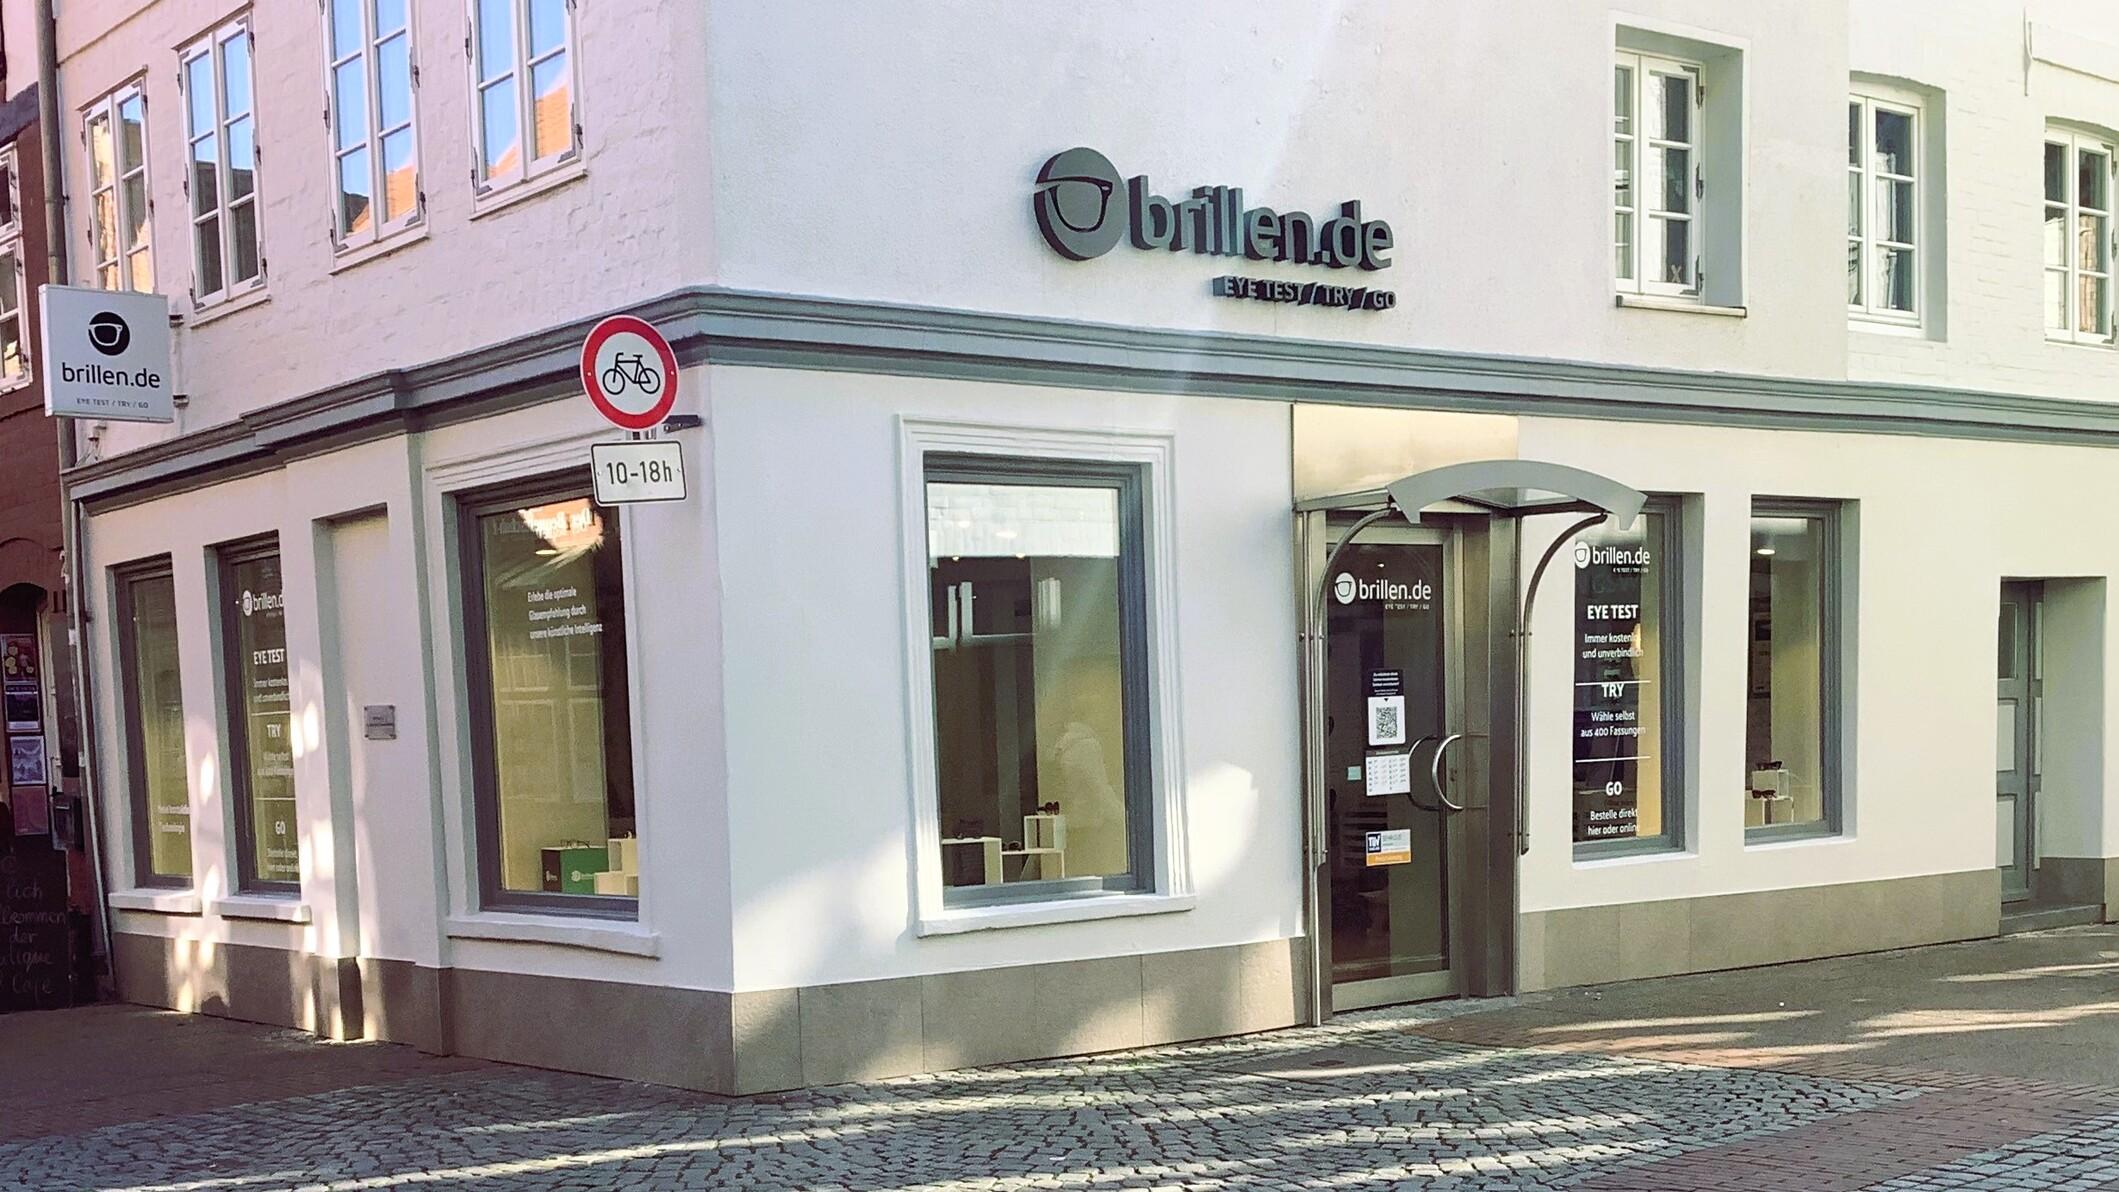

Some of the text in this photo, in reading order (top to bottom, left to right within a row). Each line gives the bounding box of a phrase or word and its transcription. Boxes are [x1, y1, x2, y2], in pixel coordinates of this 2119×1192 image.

[1128, 175, 1394, 270] brillen.de
[1214, 276, 1258, 299] EYE
[1260, 280, 1305, 304] TEST
[1321, 284, 1354, 308] TRY
[1372, 290, 1397, 311] GO
[62, 362, 161, 389] brillen.de
[93, 398, 110, 406] TEST
[118, 400, 131, 408] TRY
[606, 460, 673, 485] 10-18h
[1592, 546, 1650, 565] brillen.de
[528, 591, 544, 602] Erlebe
[545, 589, 553, 600] die
[1359, 578, 1432, 600] brillen.de
[253, 591, 284, 611] brillen.d
[1587, 604, 1639, 620] EYE TEST
[1584, 632, 1640, 643] Immer kostenlo
[253, 648, 285, 665] EYE TEST
[1582, 648, 1597, 659] und
[1601, 682, 1625, 698] TRY
[1591, 710, 1636, 722] Wähle selbst
[266, 724, 281, 738] TRY
[1581, 725, 1647, 738] aus 400 Fassungen
[1605, 781, 1623, 796] GO
[1590, 809, 1618, 821] Bestelle
[275, 820, 286, 835] GO
[1587, 825, 1602, 836] hier
[1602, 824, 1619, 835] oder
